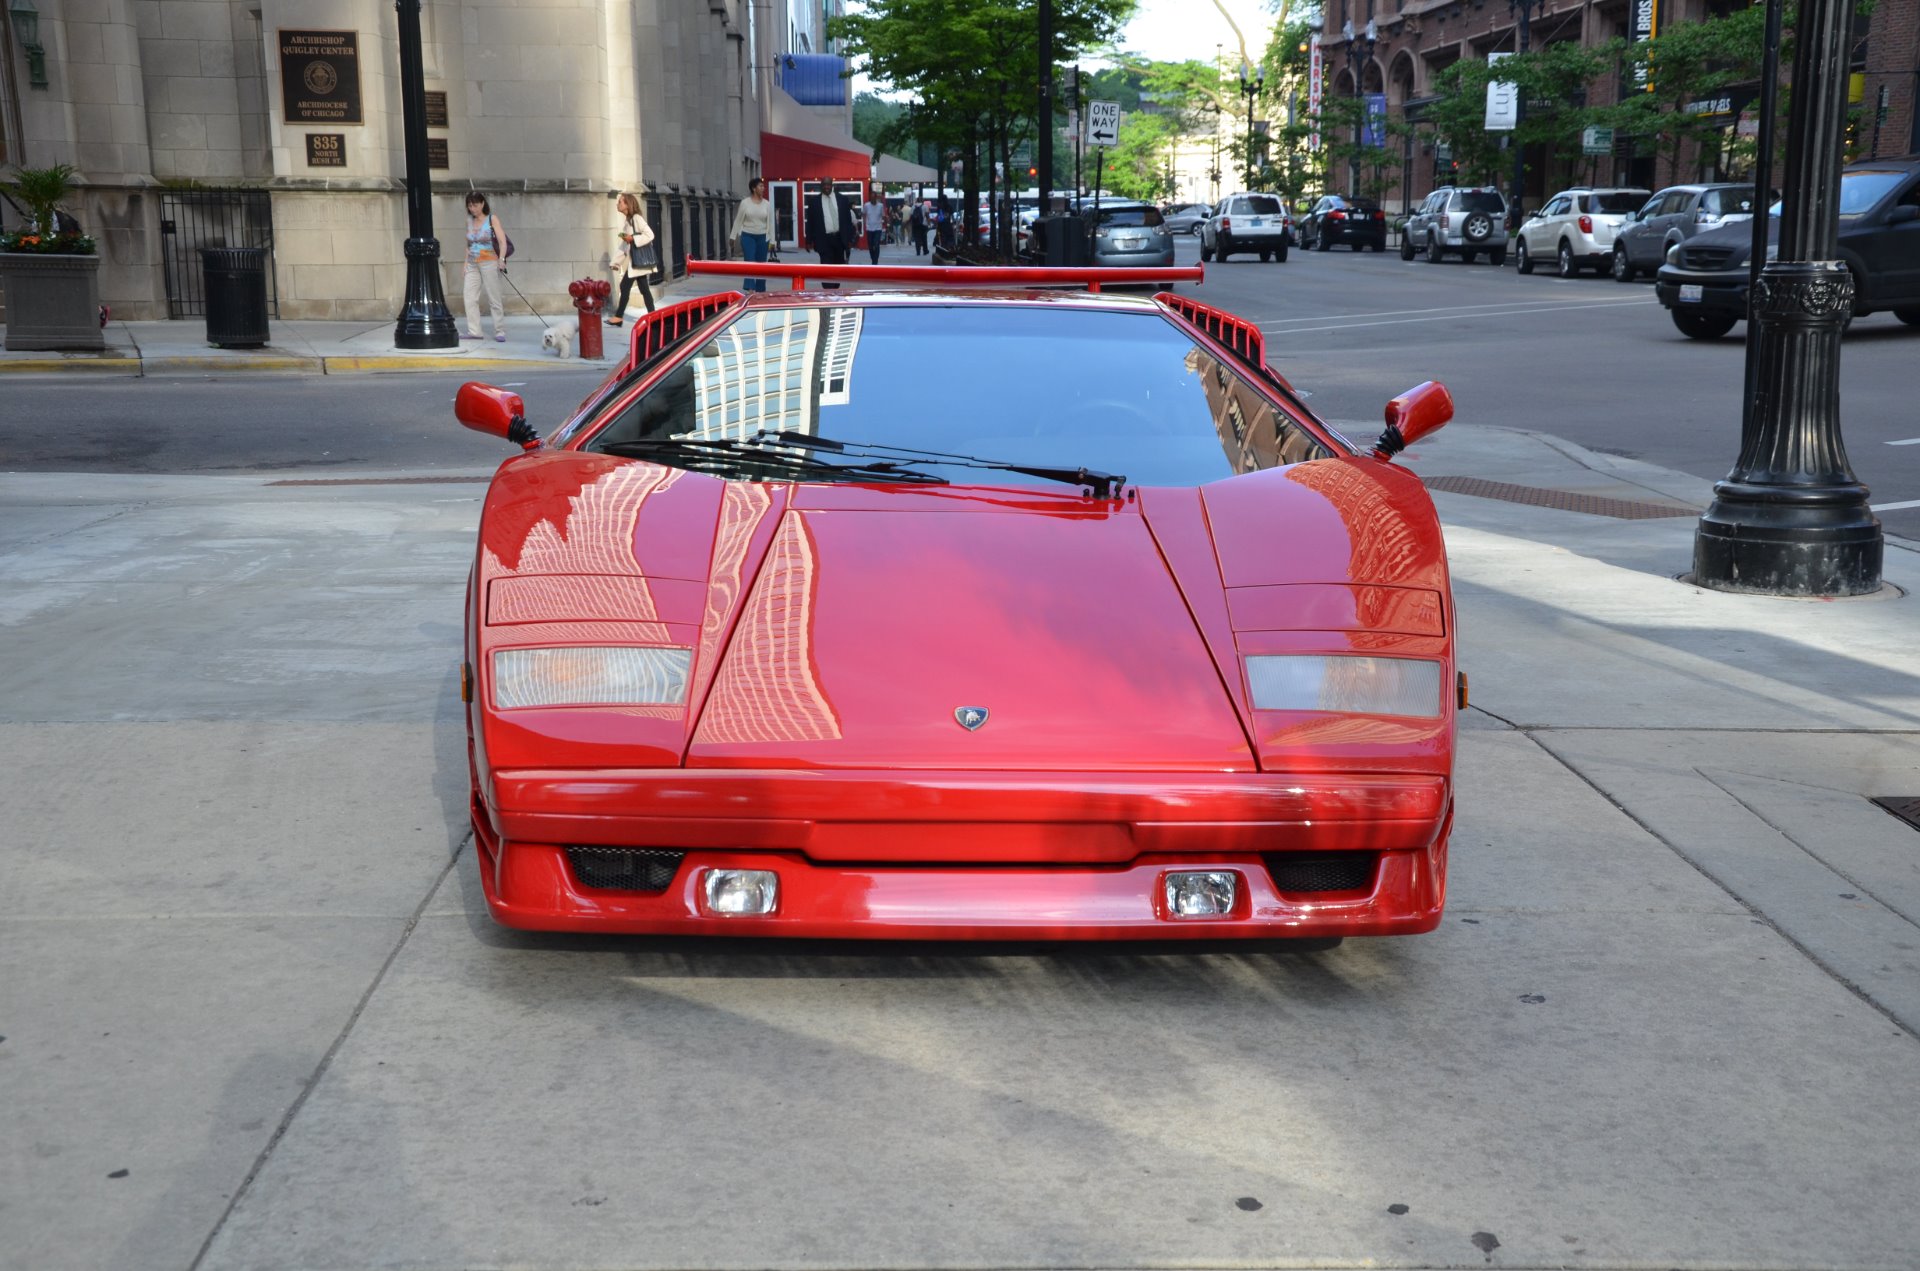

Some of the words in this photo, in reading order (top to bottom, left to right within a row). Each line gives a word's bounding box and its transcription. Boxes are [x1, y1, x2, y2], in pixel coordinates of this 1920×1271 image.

[290, 36, 345, 45] ARCHBISHOP
[282, 46, 319, 55] QUIGLEY
[320, 46, 354, 55] CENTER
[297, 100, 348, 109] ARCHDIOCESE
[301, 109, 312, 117] OF
[312, 109, 345, 118] CHICAGO
[1093, 104, 1117, 116] ONE
[1091, 117, 1117, 128] WAY
[313, 135, 338, 150] 835
